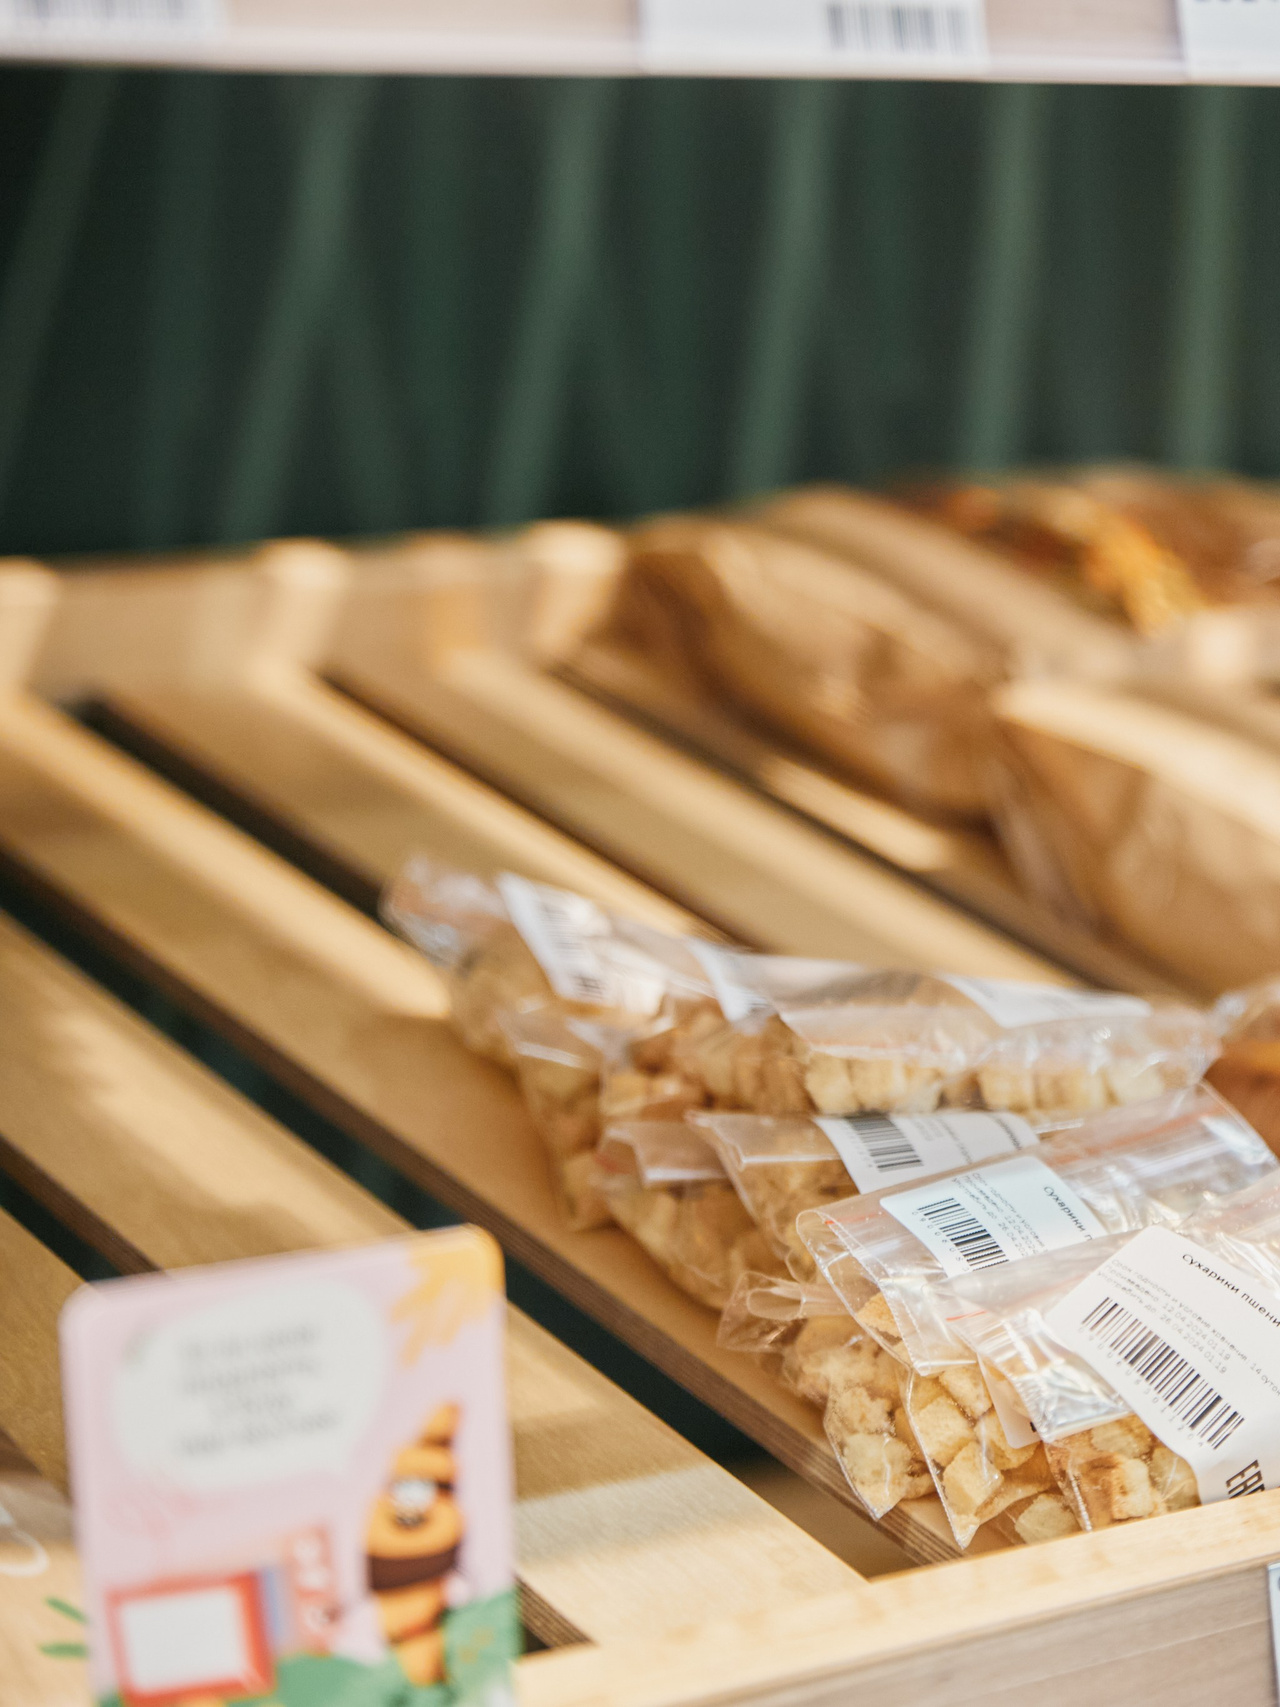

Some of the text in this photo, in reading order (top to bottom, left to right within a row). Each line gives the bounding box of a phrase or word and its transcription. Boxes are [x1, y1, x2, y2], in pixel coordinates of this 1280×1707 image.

[1043, 1186, 1087, 1233] Сухарики
[1182, 1253, 1240, 1294] Сухарики
[1179, 1302, 1211, 1329] условия
[1250, 1362, 1262, 1375] 14
[1261, 1374, 1280, 1396] суток
